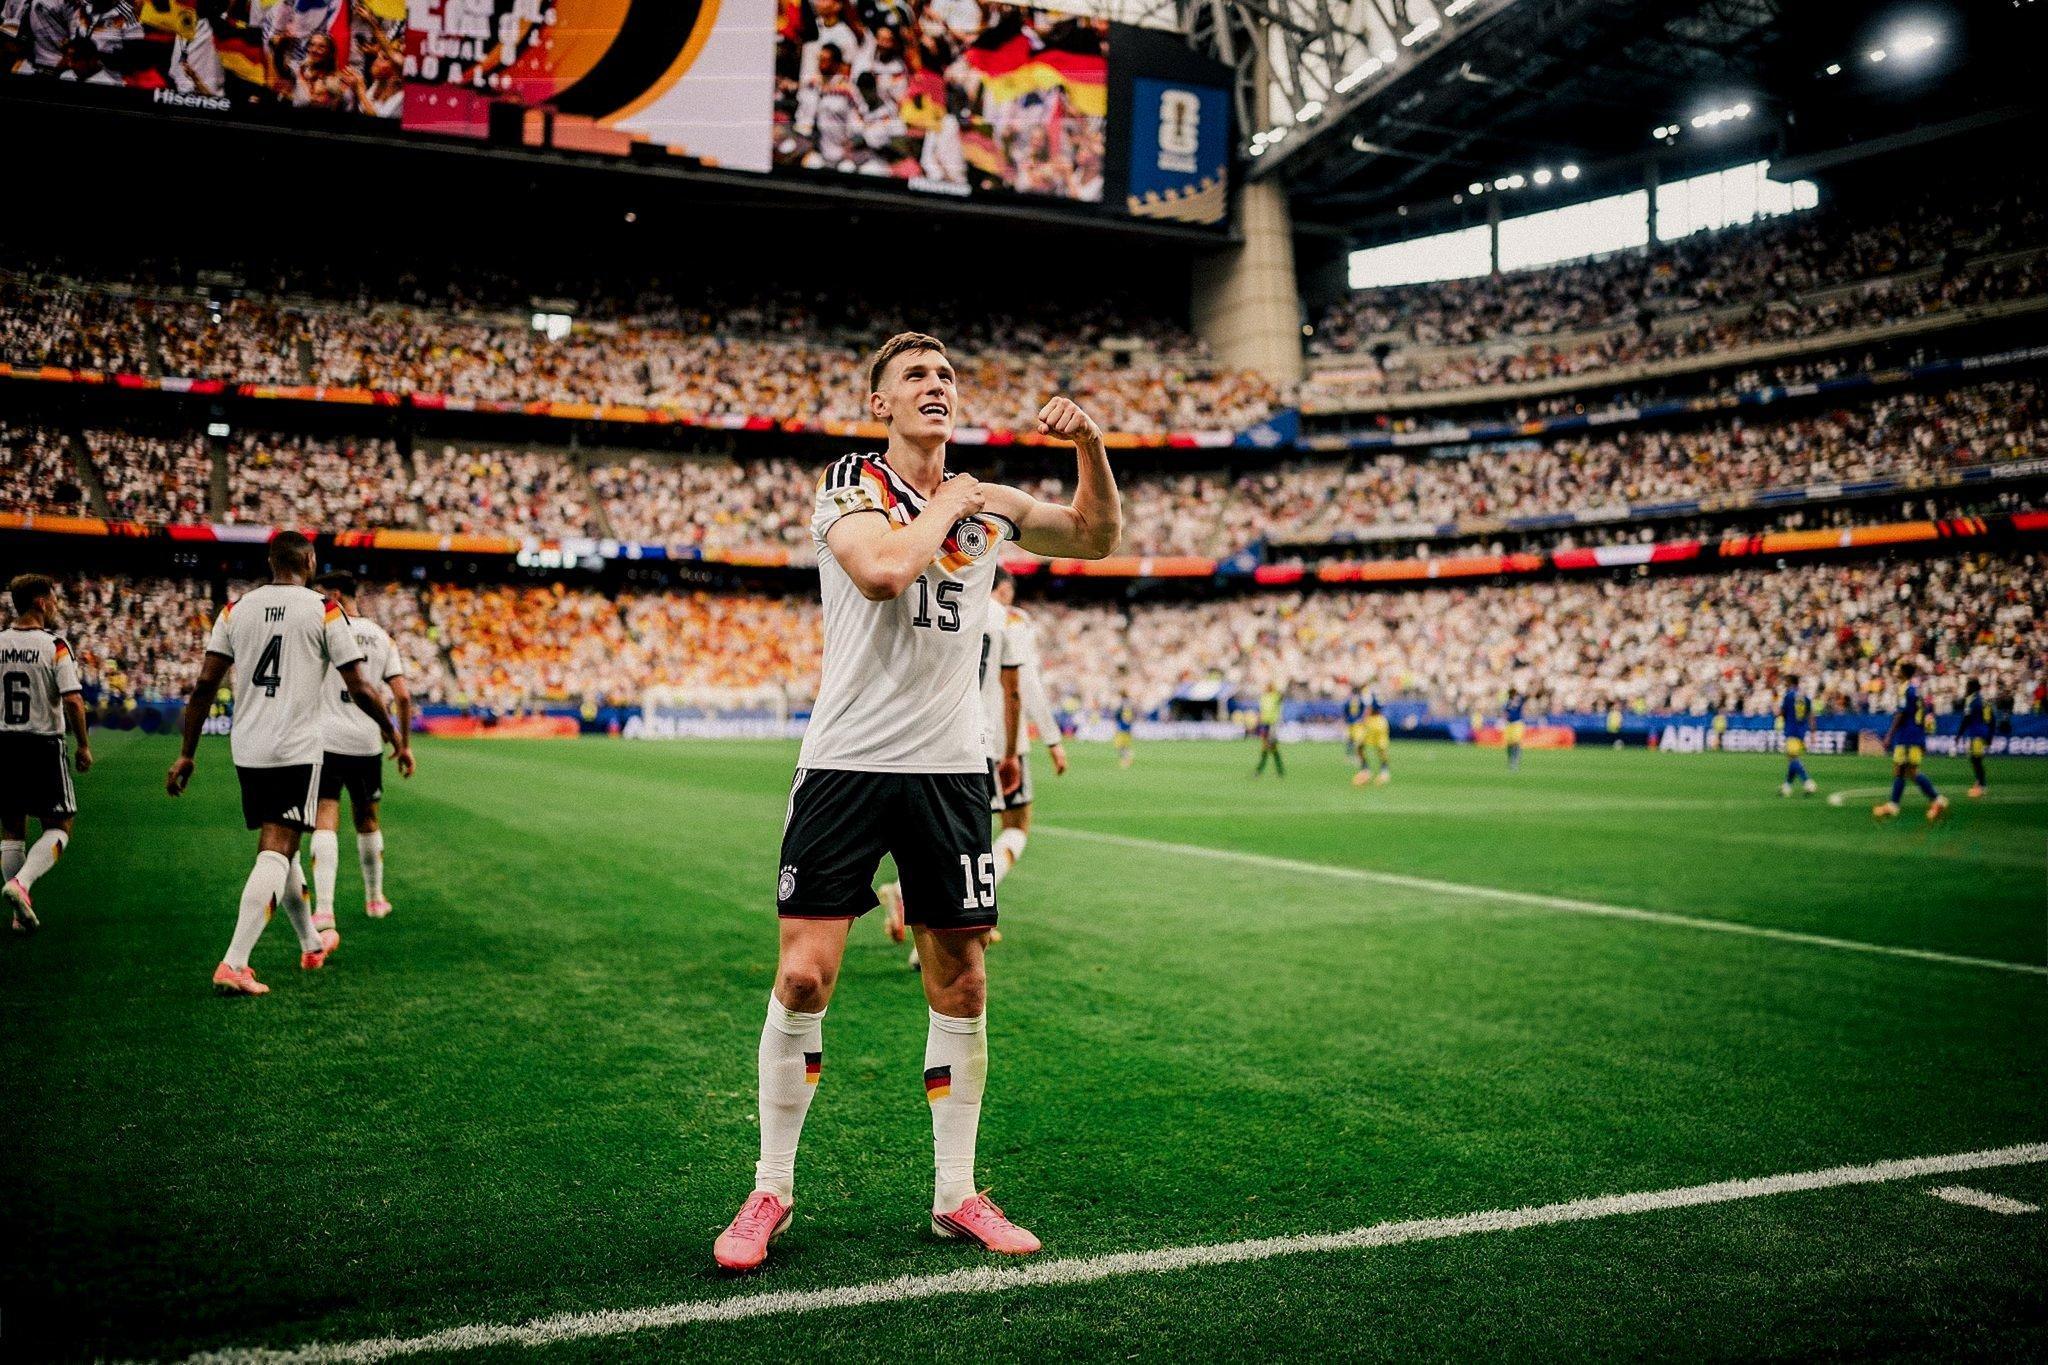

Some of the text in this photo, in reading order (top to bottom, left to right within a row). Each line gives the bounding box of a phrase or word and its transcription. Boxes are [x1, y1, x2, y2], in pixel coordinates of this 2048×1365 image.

[153, 87, 231, 111] Hisense
[264, 606, 286, 623] TAH
[912, 574, 964, 633] 15
[0, 648, 40, 664] IMMICH
[252, 634, 283, 697] 4
[3, 670, 31, 725] 6
[960, 853, 995, 909] 15
